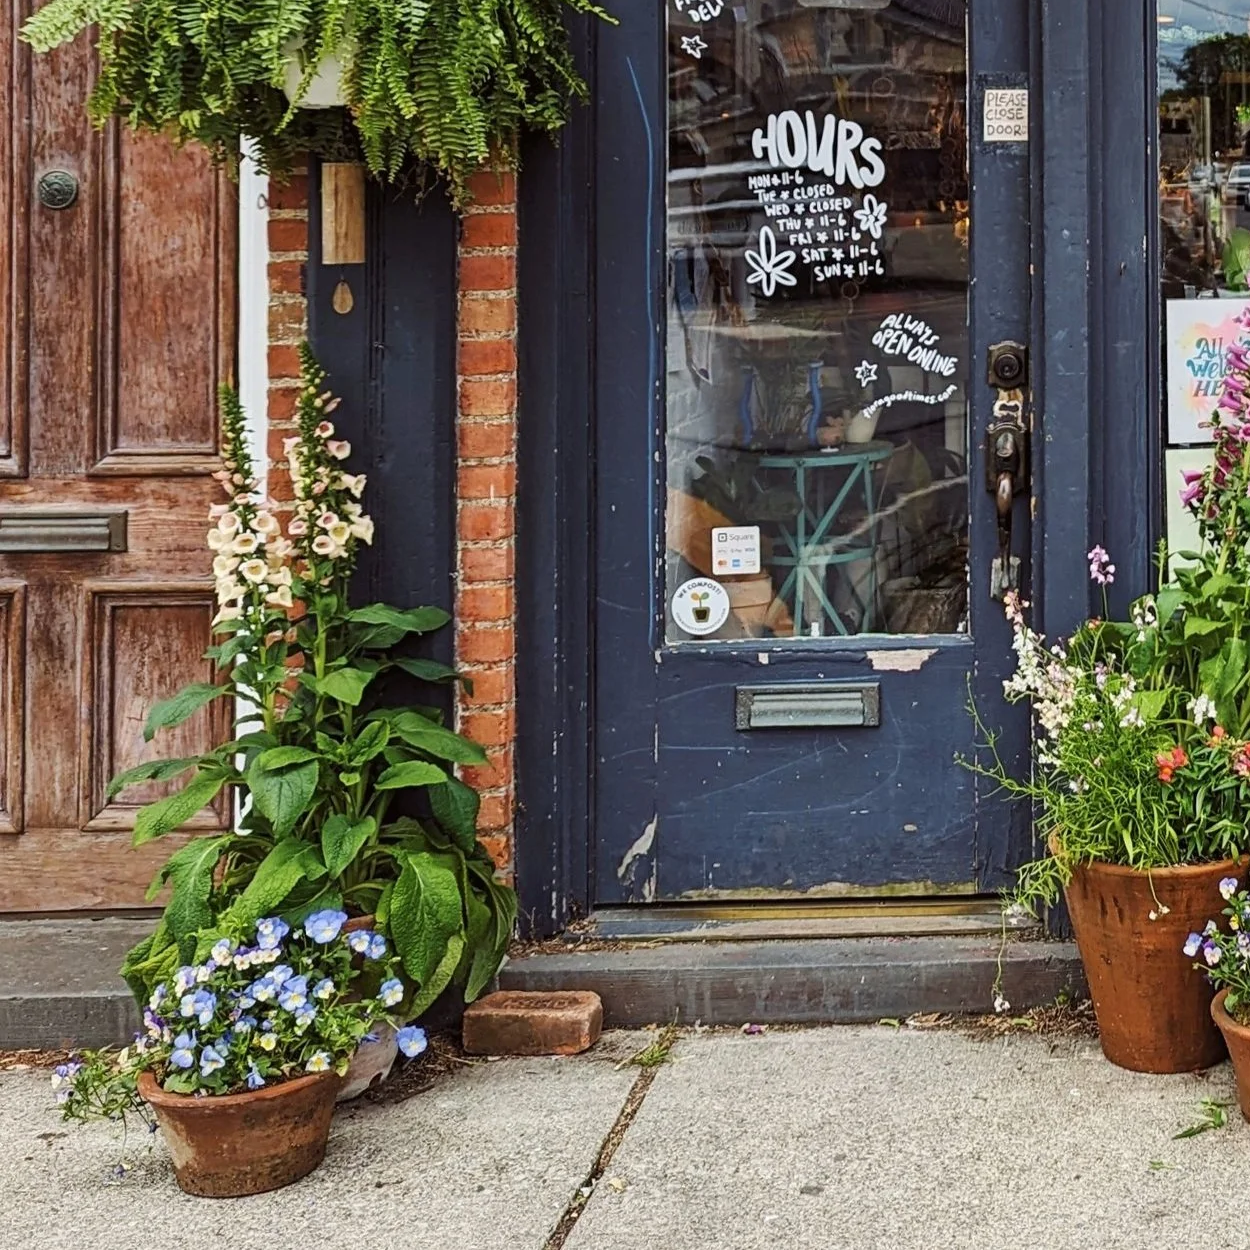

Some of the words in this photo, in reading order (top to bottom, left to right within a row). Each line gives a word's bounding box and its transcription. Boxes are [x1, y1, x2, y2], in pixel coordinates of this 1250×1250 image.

[987, 92, 1026, 107] PLEASE
[986, 108, 1024, 121] CLOSE
[987, 124, 1022, 136] DOOR
[752, 110, 885, 189] HOURS
[748, 174, 771, 190] MON
[782, 170, 804, 185] 11-6
[753, 190, 776, 203] TUE
[793, 184, 835, 200] CLOSED
[764, 203, 790, 217] WED
[809, 196, 852, 214] CLOSED
[776, 217, 801, 232] THU
[820, 213, 847, 227] 11-6
[789, 231, 812, 246] FRI
[833, 226, 861, 241] 11-6
[801, 248, 829, 264] SAT
[849, 241, 878, 259] 11-6
[814, 262, 841, 281] SUN
[858, 259, 884, 275] 11-6
[880, 313, 940, 345] ALWAYS
[872, 329, 913, 355] OPEN
[907, 346, 958, 376] ONLINE
[1193, 337, 1223, 359] All
[863, 384, 958, 419] floragoodtimes.com
[729, 533, 755, 542] Square
[677, 589, 687, 599] WE
